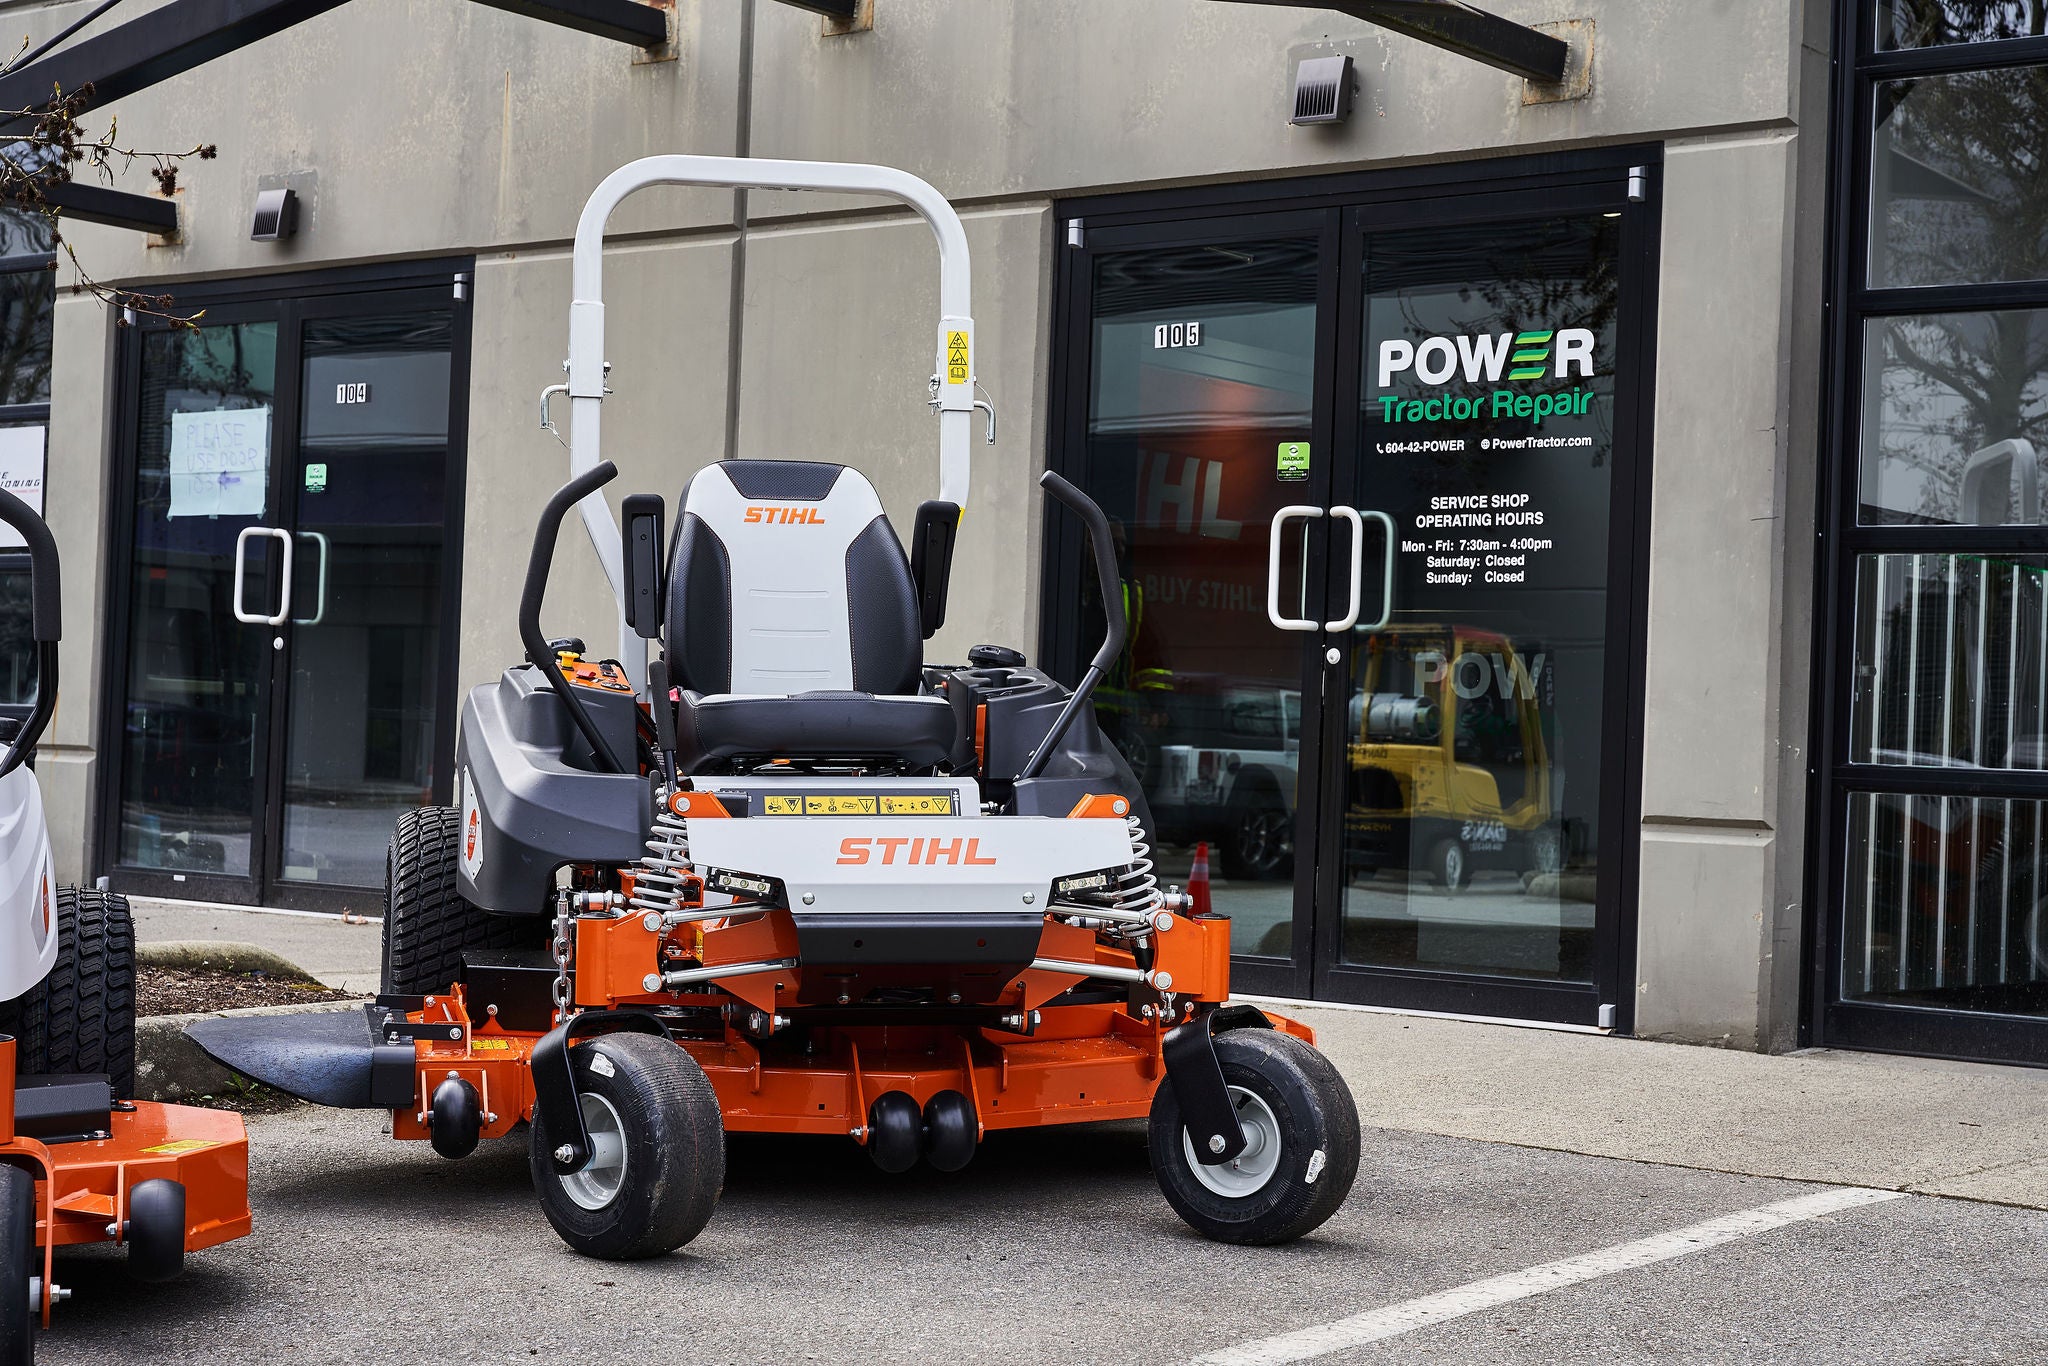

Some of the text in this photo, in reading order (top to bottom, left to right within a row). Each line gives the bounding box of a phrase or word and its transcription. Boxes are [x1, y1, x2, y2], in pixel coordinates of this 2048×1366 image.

[1158, 325, 1197, 346] 105
[1378, 328, 1595, 387] POWER
[339, 385, 365, 402] 104
[1378, 387, 1595, 424] Tractor Repair
[186, 423, 246, 449] PLEASE
[1492, 436, 1592, 450] PowerTractor.com
[1385, 440, 1465, 454] 604-42-POWER
[186, 447, 257, 472] USE DOOR
[1431, 494, 1530, 510] SERVICE SHOP
[743, 506, 825, 524] STIHL
[1416, 511, 1544, 528] OPERATING HOURS
[1402, 540, 1426, 552] Mon
[1435, 539, 1454, 552] Fri:
[1459, 539, 1500, 551] 7:30am
[1510, 538, 1553, 552] 4:00pm
[1426, 554, 1525, 570] Saturday: Closed
[1426, 570, 1525, 586] Sunday: Closed
[1145, 574, 1193, 606] BUY
[1413, 652, 1546, 700] POW
[835, 837, 997, 865] STIHL
